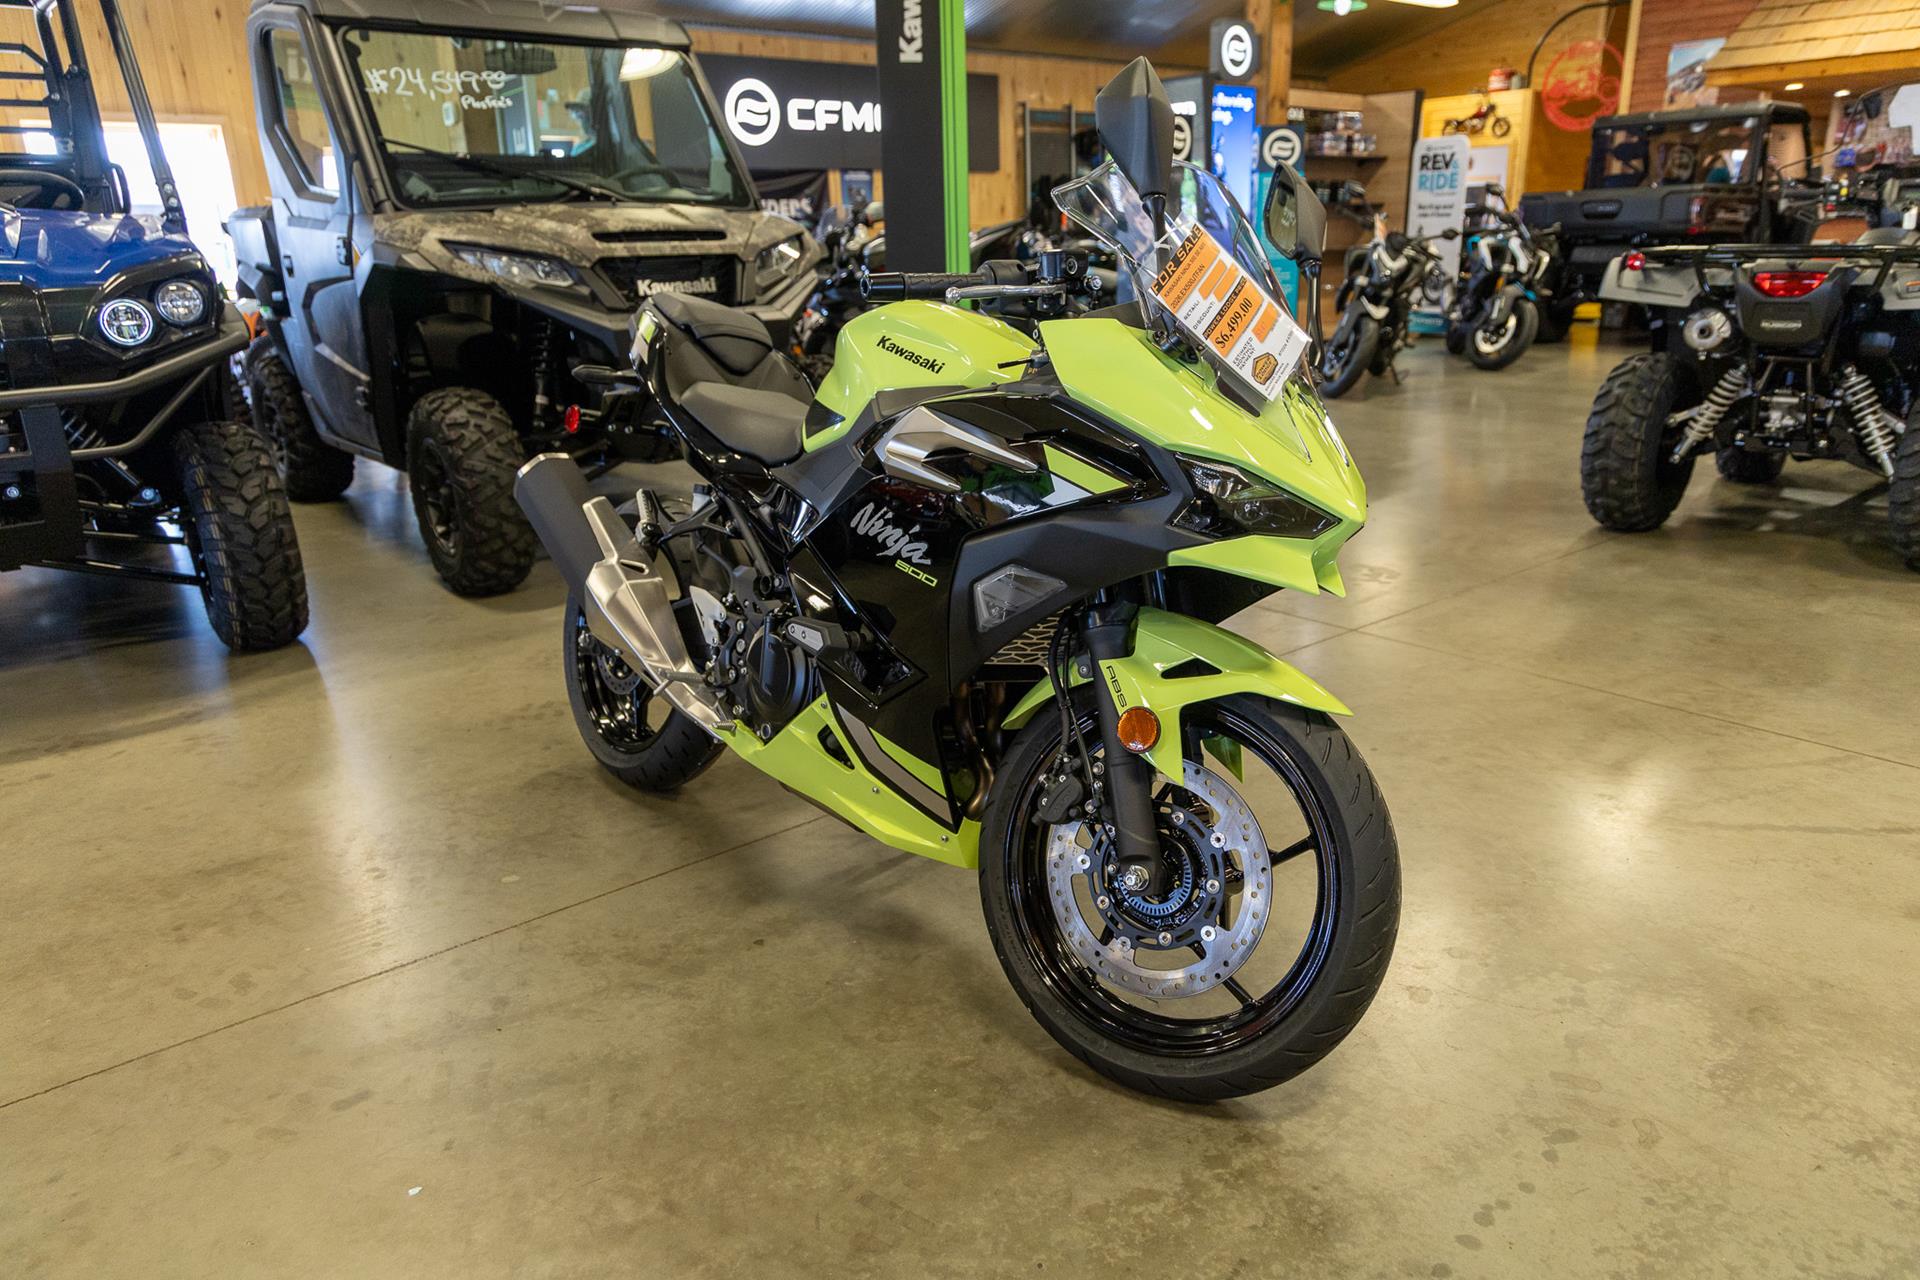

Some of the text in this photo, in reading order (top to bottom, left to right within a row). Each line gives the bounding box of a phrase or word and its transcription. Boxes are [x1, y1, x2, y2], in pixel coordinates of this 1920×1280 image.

[1419, 152, 1456, 171] REV
[1418, 172, 1459, 193] RIDE
[1152, 225, 1203, 294] FOR SALE
[637, 277, 716, 297] Kawasaki
[1203, 313, 1222, 339] POWER
[1219, 292, 1236, 315] LODGE
[1214, 297, 1253, 349] $6,499.00
[876, 335, 945, 374] Kawasaki
[850, 502, 932, 565] Ninja
[895, 560, 938, 587] 500
[1106, 665, 1128, 708] ABS
